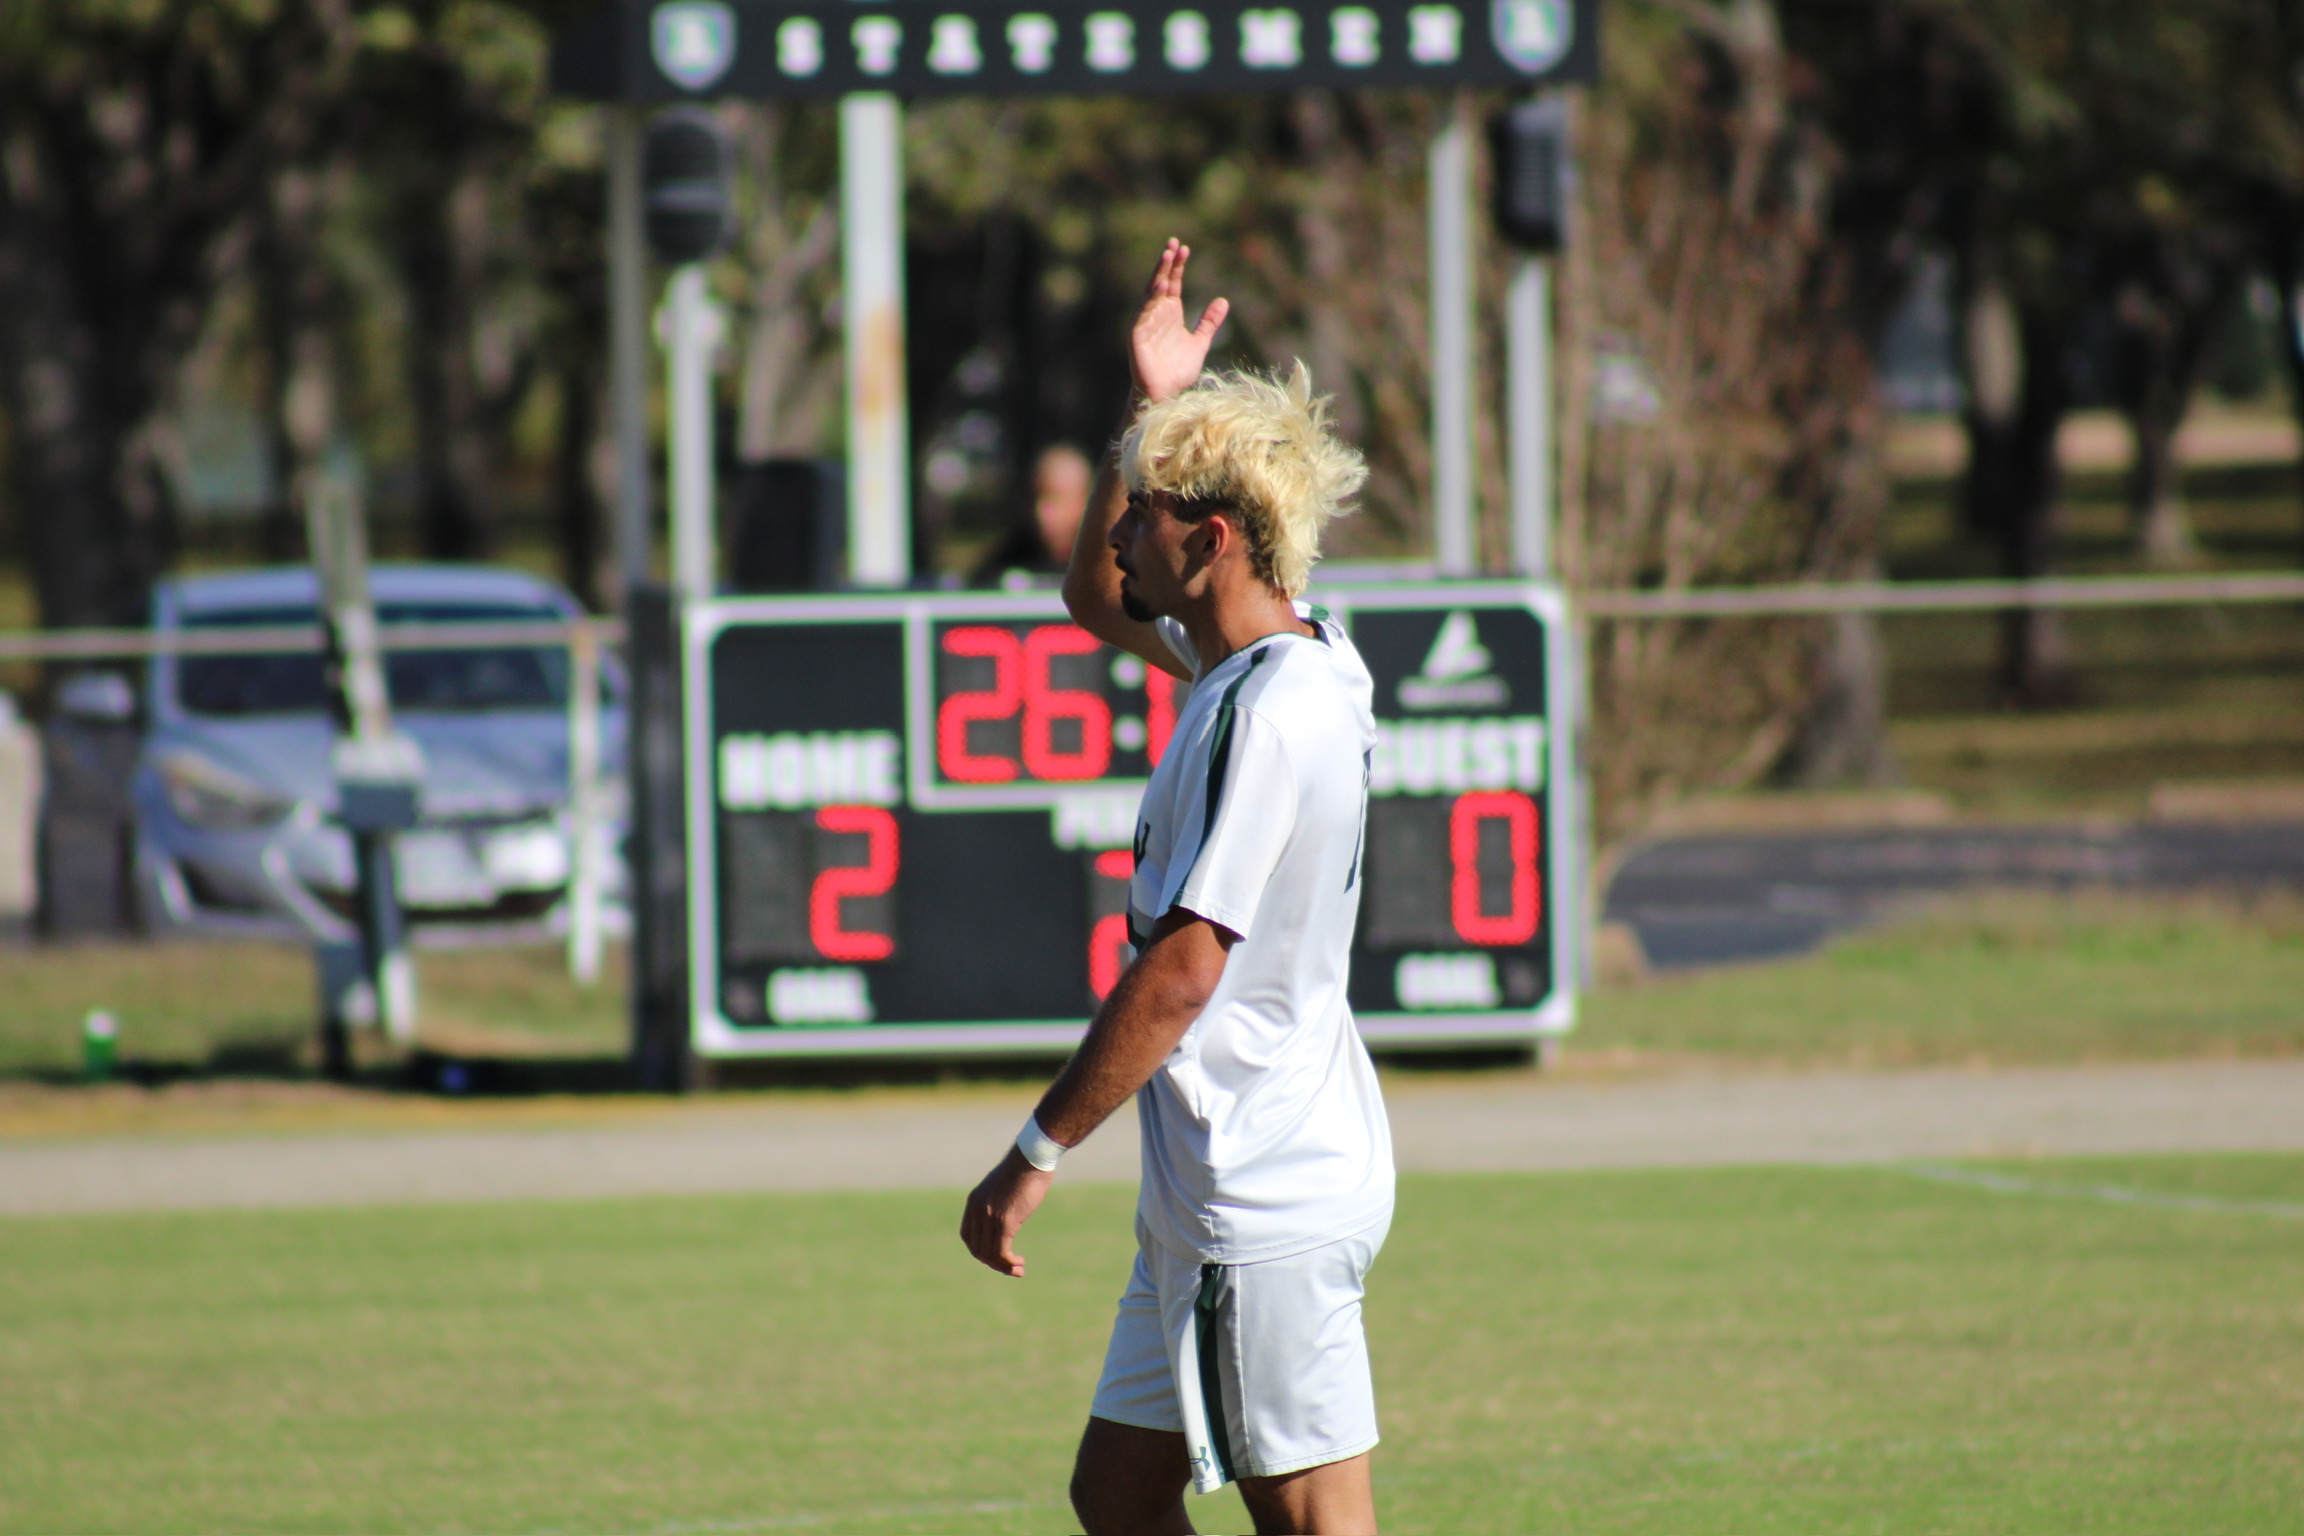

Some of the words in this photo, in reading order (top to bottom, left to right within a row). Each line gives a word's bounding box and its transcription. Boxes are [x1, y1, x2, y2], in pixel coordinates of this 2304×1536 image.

[776, 5, 1461, 77] STATESMEN
[721, 732, 899, 810] HOME
[1369, 717, 1545, 794] GUEST
[810, 804, 899, 961] 2
[1450, 790, 1541, 946] 0
